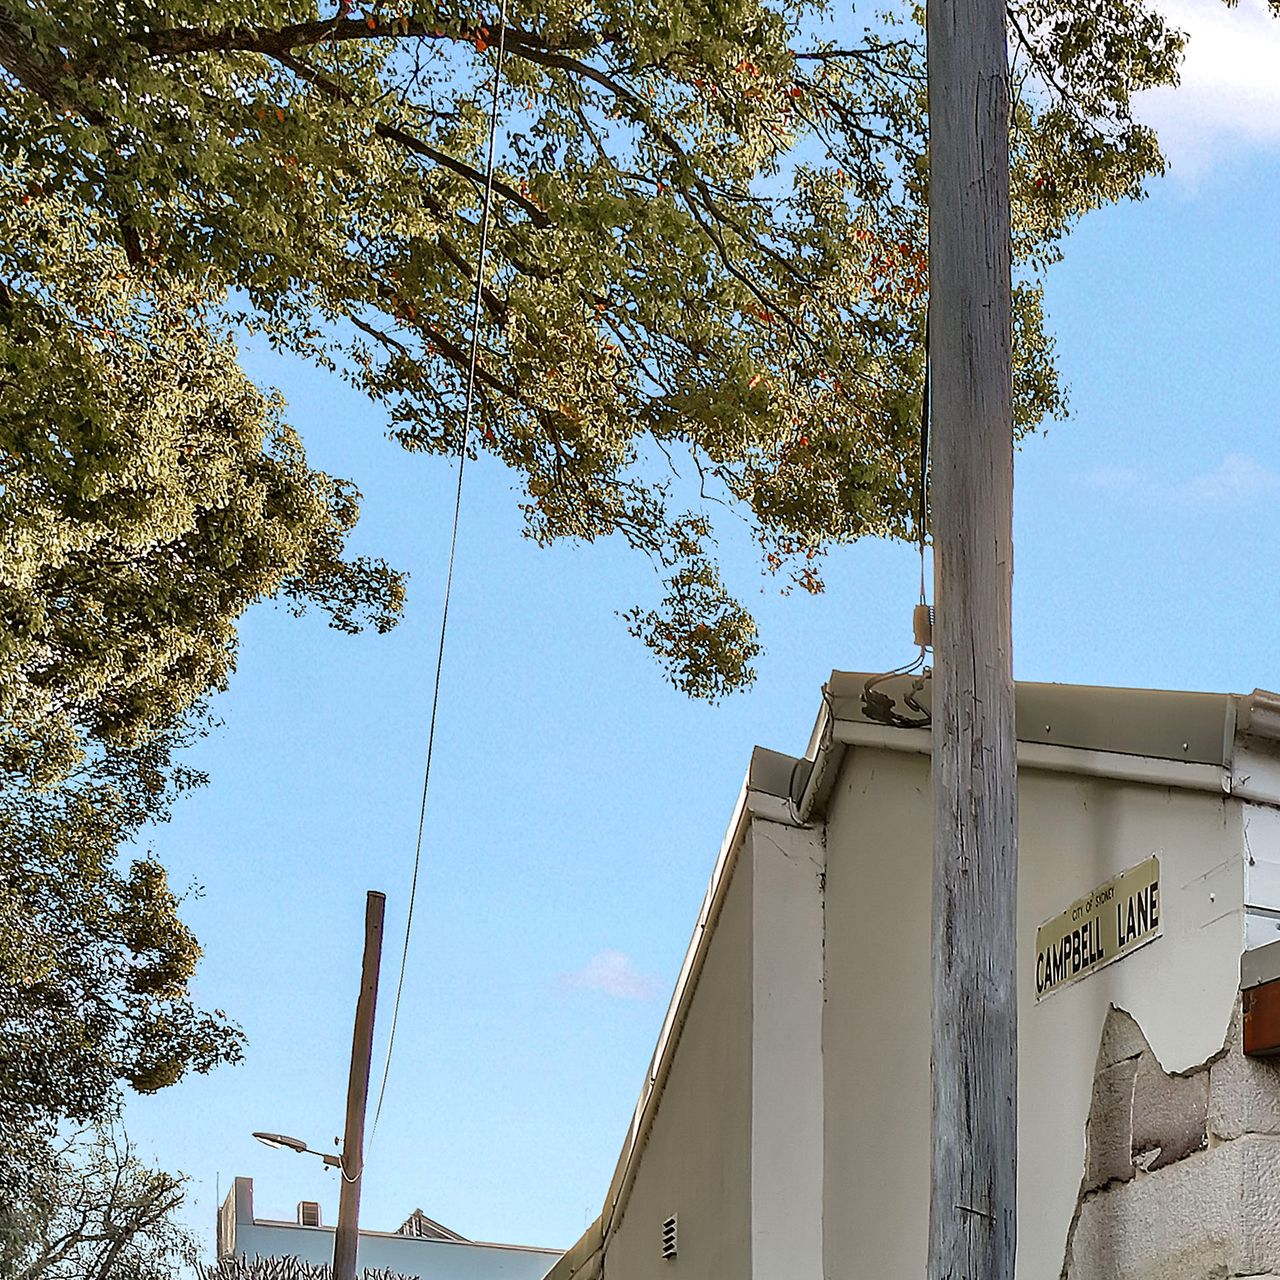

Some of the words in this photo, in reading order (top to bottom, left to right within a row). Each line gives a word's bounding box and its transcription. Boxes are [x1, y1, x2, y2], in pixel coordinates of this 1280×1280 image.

[1036, 917, 1104, 994] CAMPBELL
[1117, 881, 1159, 947] LANE
[1071, 907, 1084, 922] CITY
[1086, 899, 1093, 914] OF
[1095, 887, 1115, 908] SYDNEY
